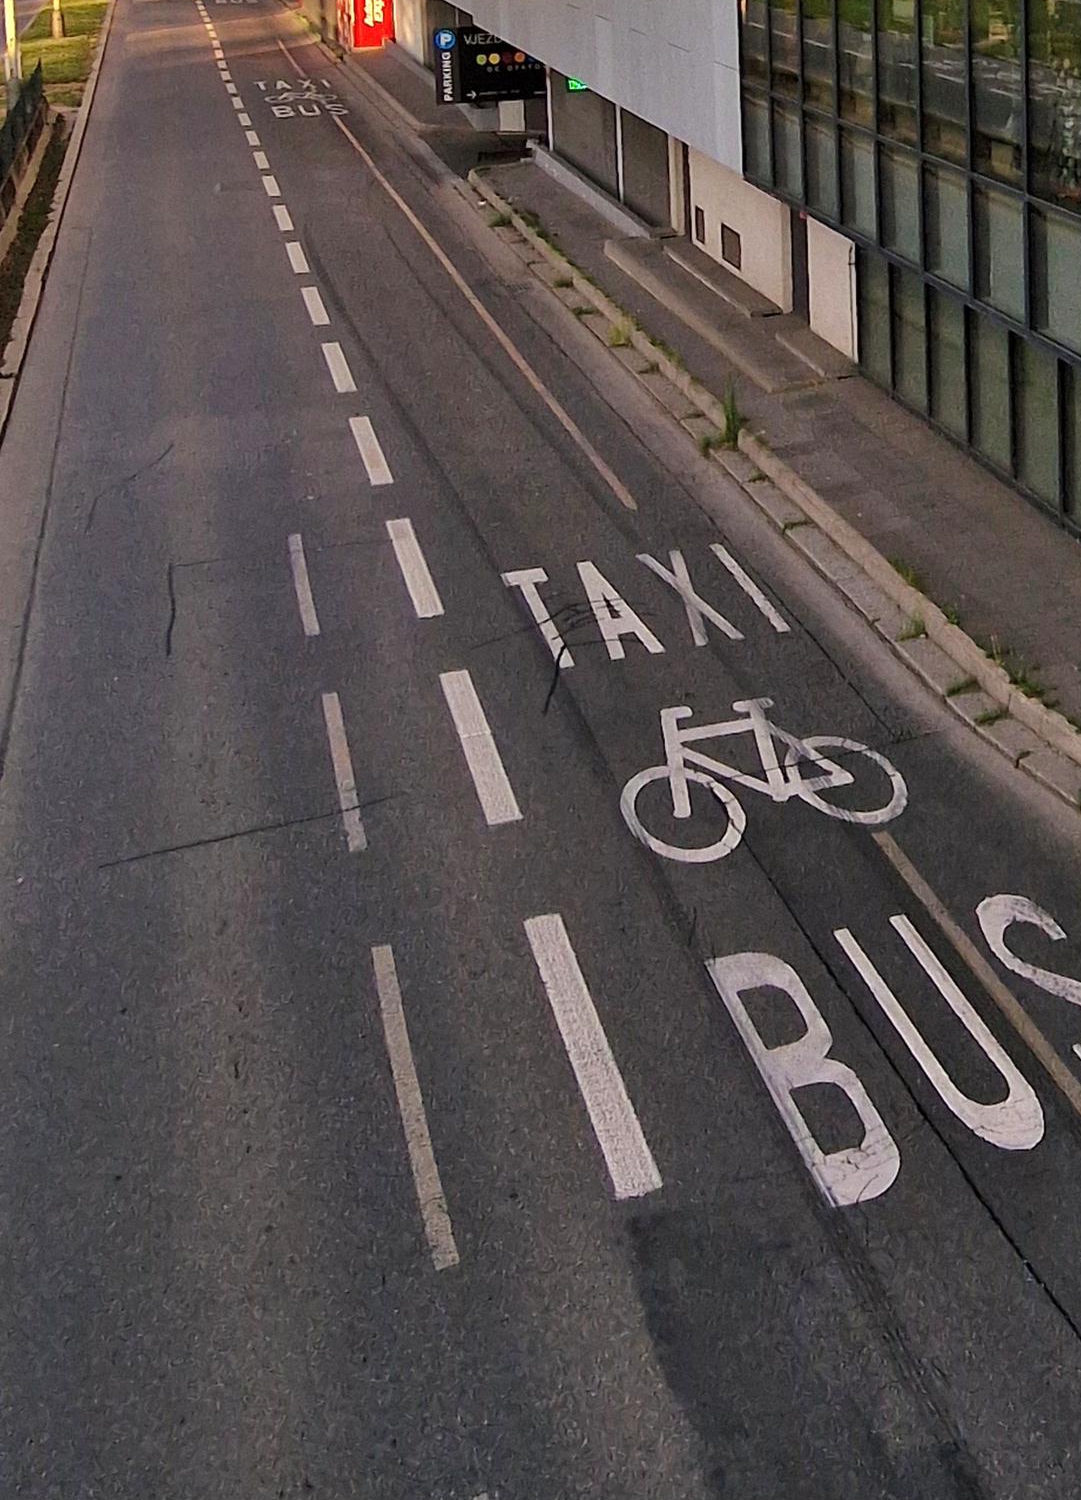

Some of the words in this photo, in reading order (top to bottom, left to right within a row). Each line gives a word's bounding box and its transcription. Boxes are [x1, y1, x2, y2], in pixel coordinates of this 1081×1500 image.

[253, 79, 331, 91] TAXI
[441, 51, 454, 102] PARKING
[271, 103, 349, 119] BUS
[500, 543, 790, 668] TAXI
